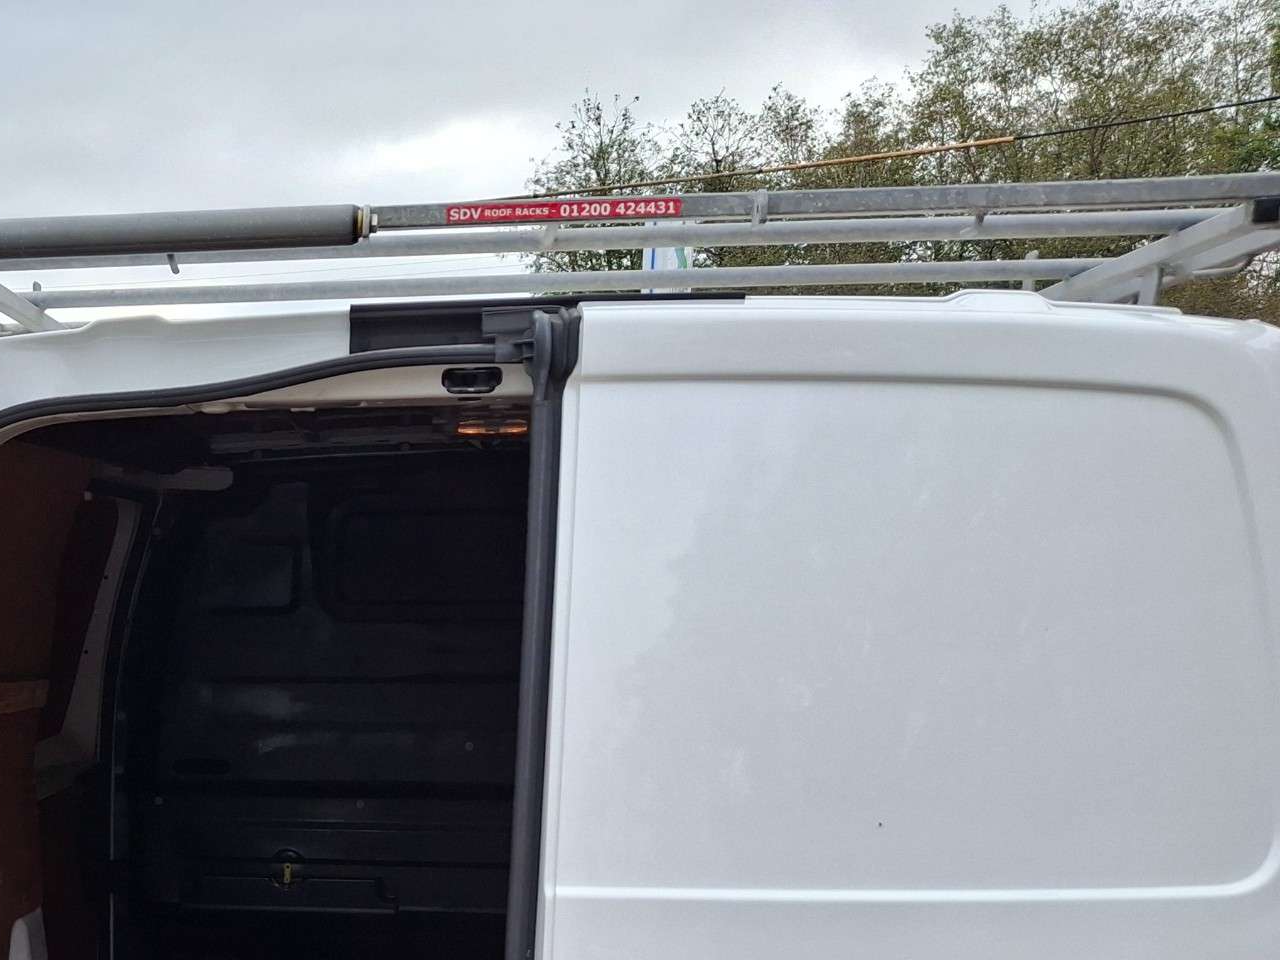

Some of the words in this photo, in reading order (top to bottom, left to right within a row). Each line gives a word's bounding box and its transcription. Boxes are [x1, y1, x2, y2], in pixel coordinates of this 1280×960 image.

[449, 206, 481, 221] SDV
[484, 208, 513, 217] ROOF
[515, 207, 550, 216] RACKS
[560, 203, 611, 217] 01200
[615, 201, 676, 215] 424431
